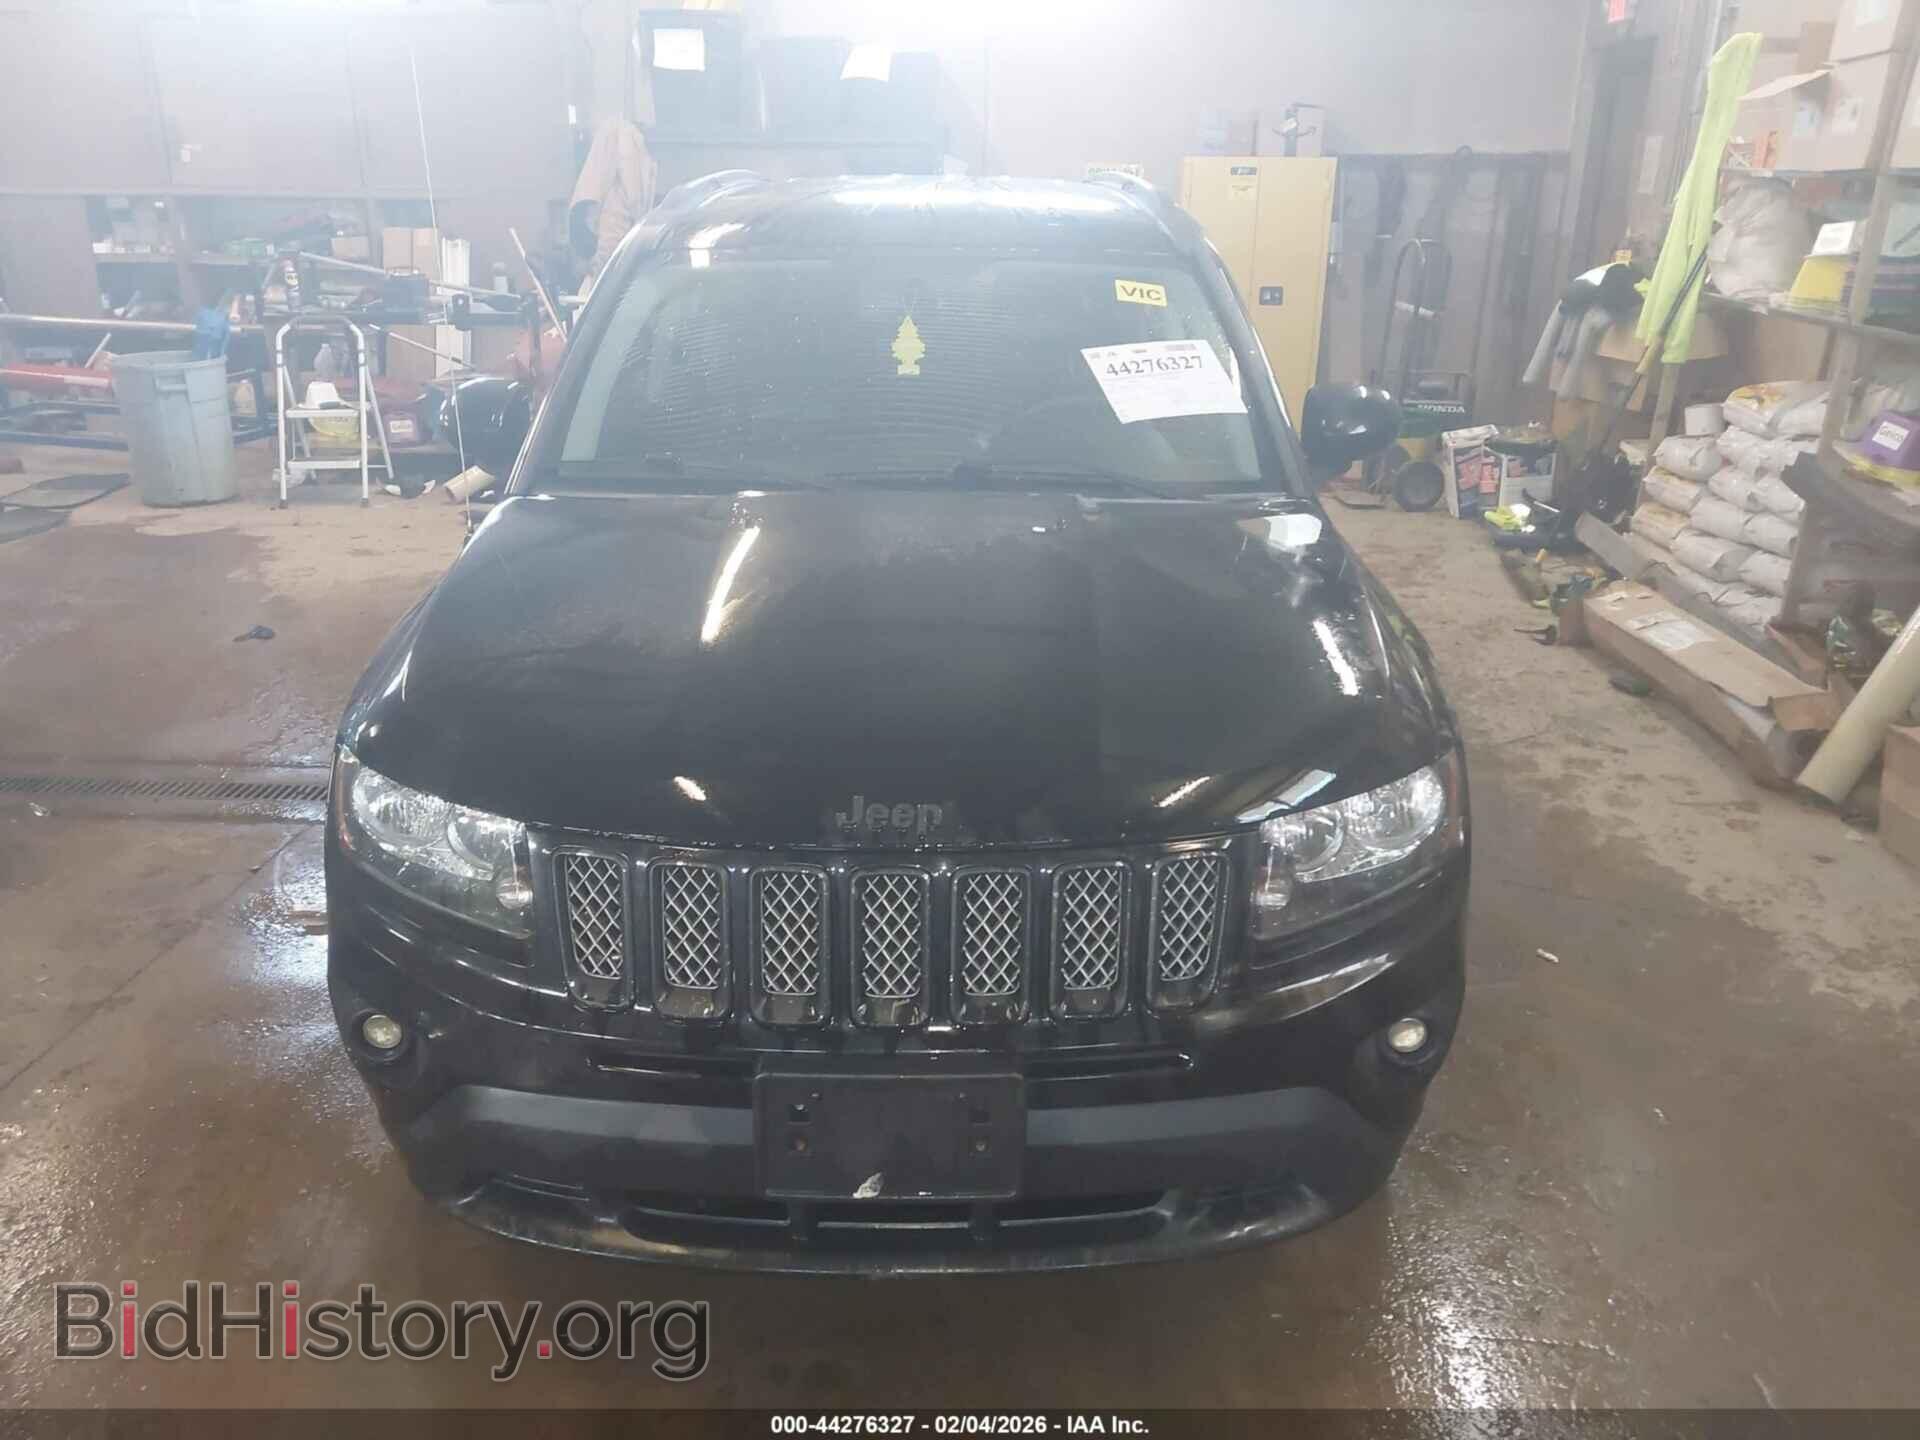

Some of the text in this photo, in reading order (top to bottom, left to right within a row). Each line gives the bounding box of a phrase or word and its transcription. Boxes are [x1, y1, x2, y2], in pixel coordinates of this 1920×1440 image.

[1120, 285, 1162, 301] VIC
[1106, 355, 1203, 376] 44276327
[834, 795, 943, 839] Jeep
